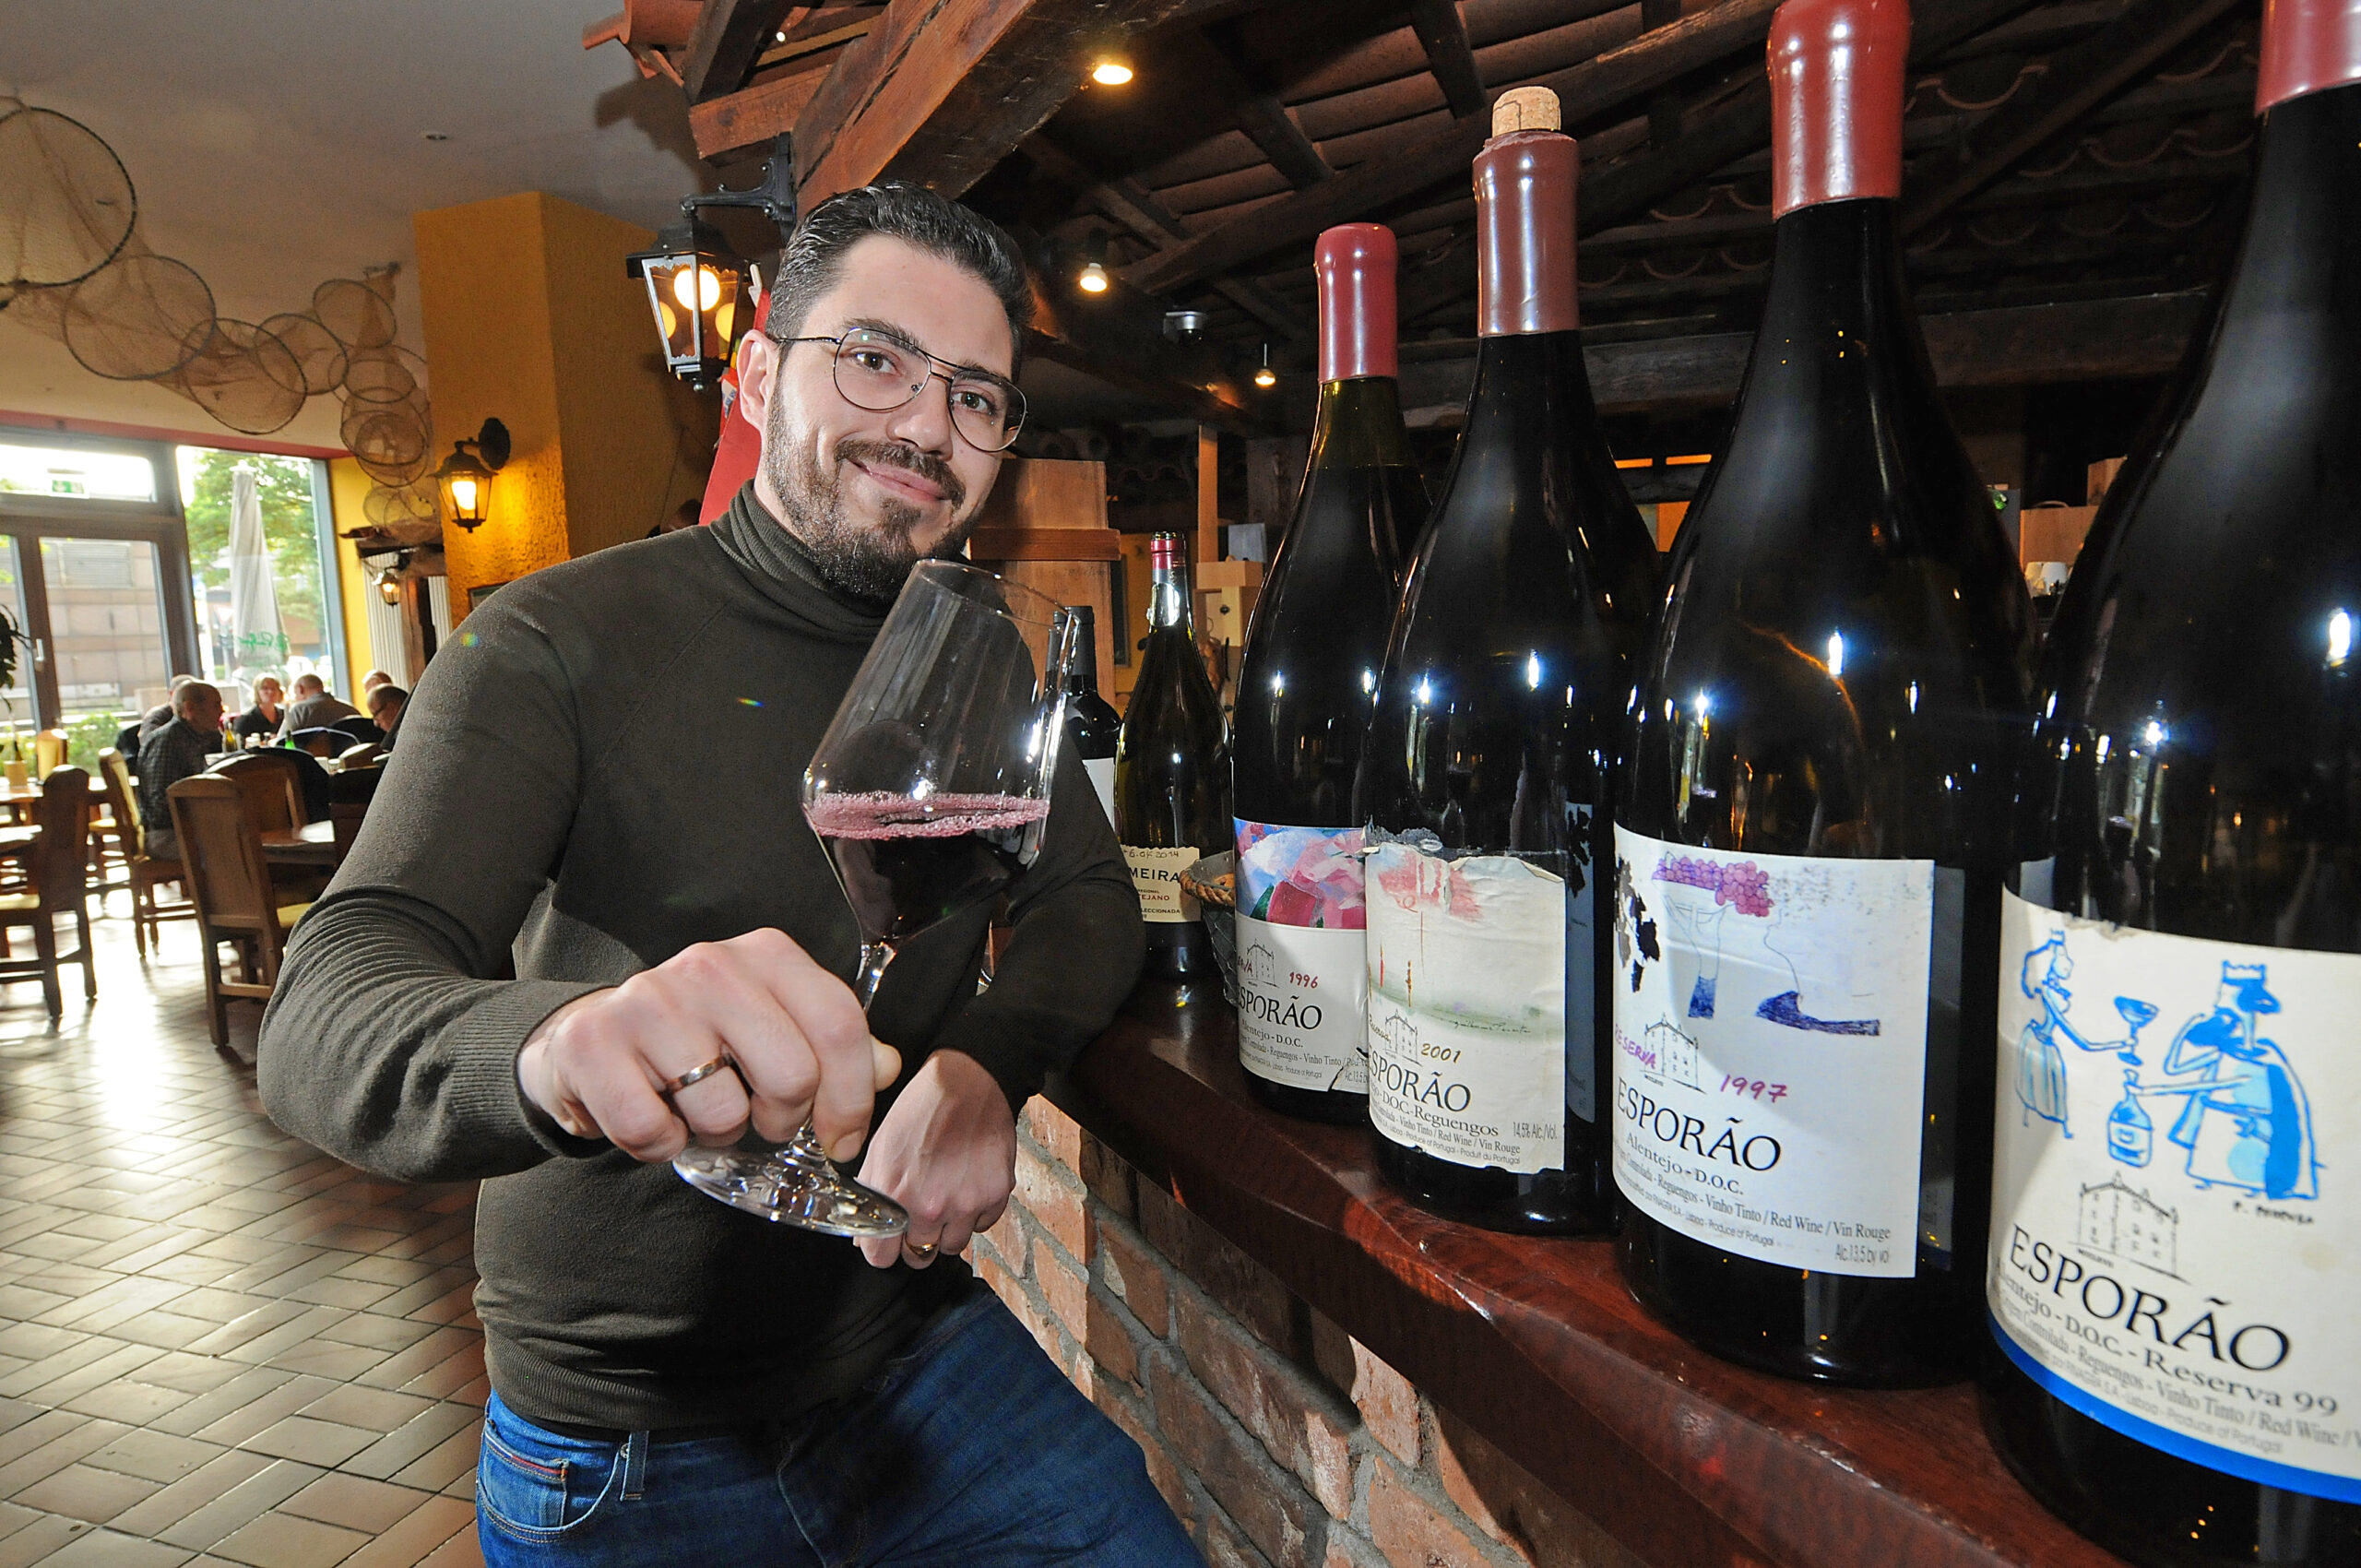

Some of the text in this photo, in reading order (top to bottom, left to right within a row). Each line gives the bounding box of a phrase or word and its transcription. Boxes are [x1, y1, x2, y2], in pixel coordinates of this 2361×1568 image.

[1289, 971, 1318, 989] 1996
[1303, 1052, 1323, 1065] Vinho
[1324, 1055, 1342, 1066] Tinto
[1421, 1043, 1462, 1063] 2001
[1720, 1074, 1788, 1103] 1997
[1417, 1123, 1433, 1137] Tinto
[1439, 1130, 1452, 1143] Red
[1453, 1133, 1473, 1146] Wine
[1478, 1138, 1492, 1150] Vin
[1494, 1140, 1521, 1154] Rouge
[1618, 1077, 1781, 1170] ESPORÃO
[1432, 1139, 1456, 1154] Portugal
[1492, 1153, 1520, 1165] Portugal
[1705, 1194, 1734, 1215] Vinho
[1735, 1203, 1762, 1223] Tinto
[1770, 1211, 1792, 1229] Red
[1795, 1216, 1823, 1234] Wine
[1833, 1221, 1853, 1238] Vin
[1855, 1224, 1891, 1242] Rouge
[2011, 1223, 2291, 1372] ESPORÃO
[2144, 1348, 2282, 1408] Reserva
[2294, 1390, 2339, 1417] 99
[2155, 1379, 2201, 1409] Vinho
[2205, 1396, 2245, 1424] Tinto
[2259, 1411, 2292, 1437] Red
[2295, 1419, 2341, 1446] Wine
